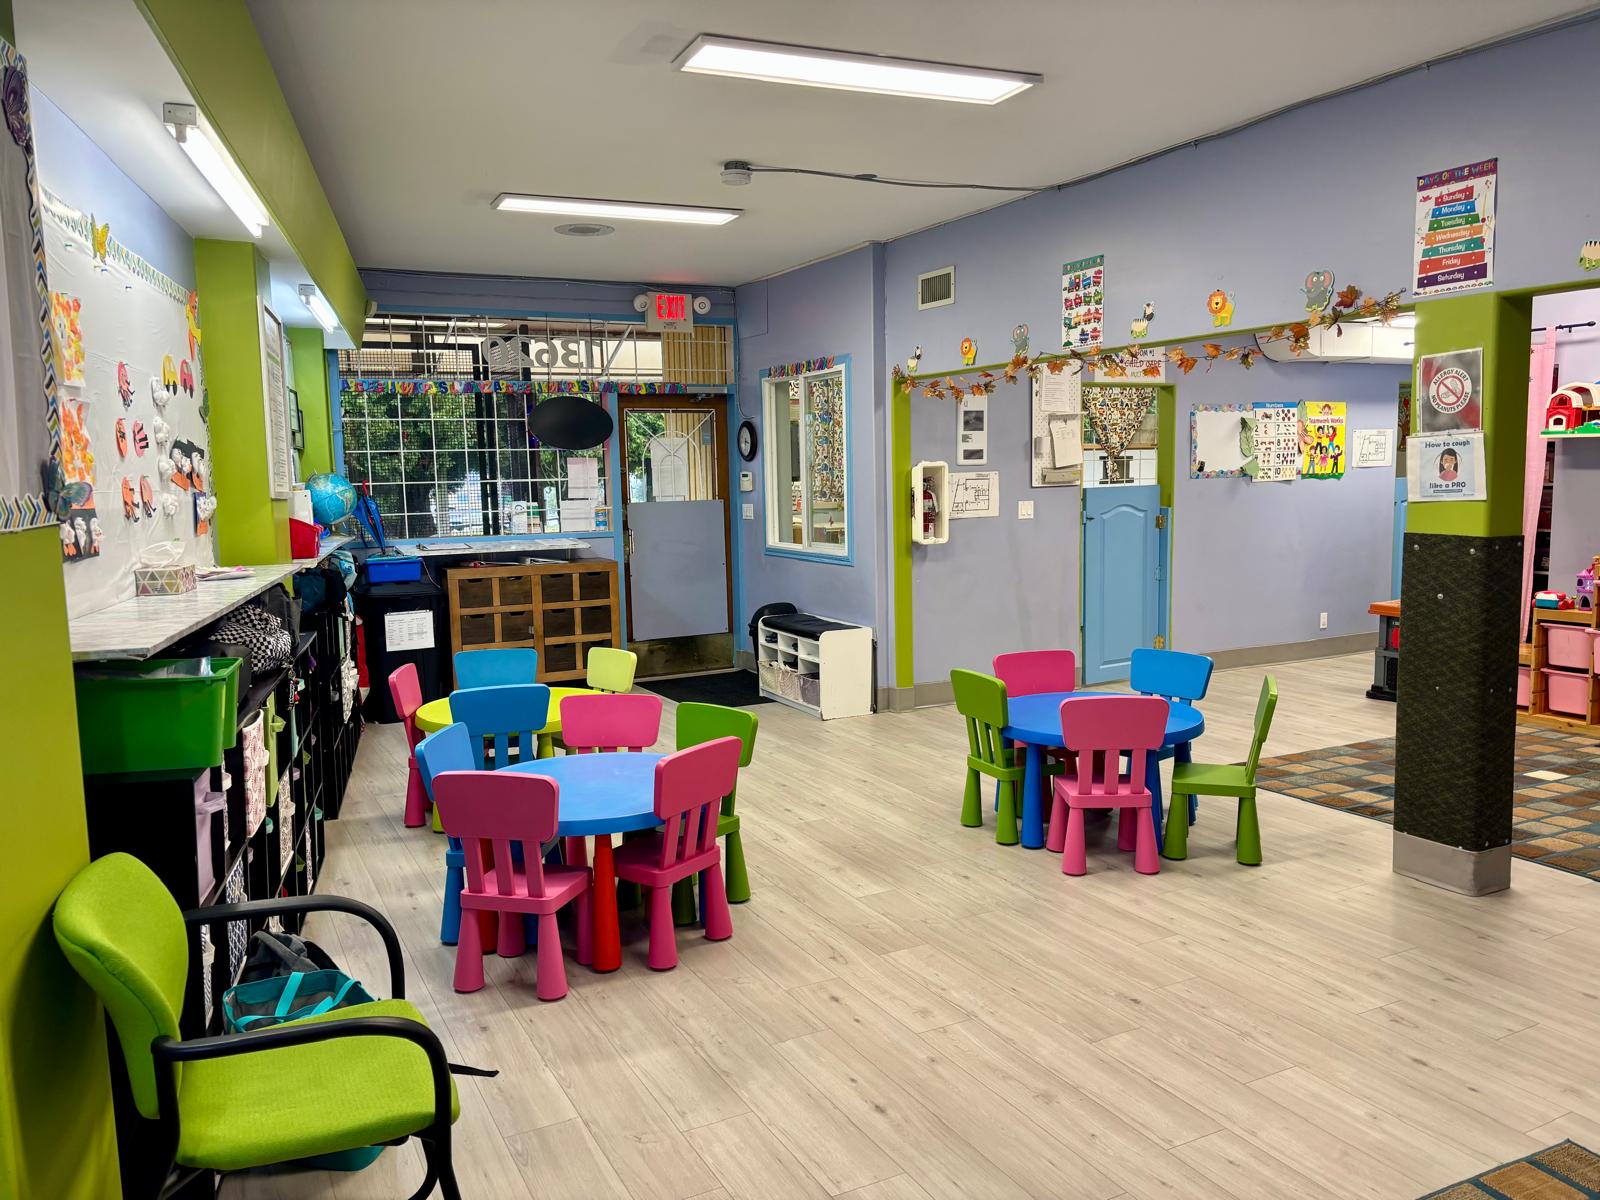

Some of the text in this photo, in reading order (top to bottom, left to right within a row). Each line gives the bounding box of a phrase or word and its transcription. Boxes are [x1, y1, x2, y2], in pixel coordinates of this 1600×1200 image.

[1419, 162, 1495, 187] DAYS OF THE WEEK
[1443, 191, 1465, 201] Sunday
[1441, 204, 1465, 214] Monday
[1441, 218, 1466, 227] Tuesday
[1435, 230, 1470, 241] Wednesday
[1439, 243, 1466, 253] Thursday
[1442, 257, 1461, 266] Friday
[1437, 272, 1465, 281] Saturday
[656, 294, 686, 320] EXIT
[1433, 369, 1468, 386] ALLERGY ALERT
[1435, 403, 1456, 412] PEANUTS
[1456, 392, 1470, 410] PLEASE
[1274, 467, 1280, 475] 10
